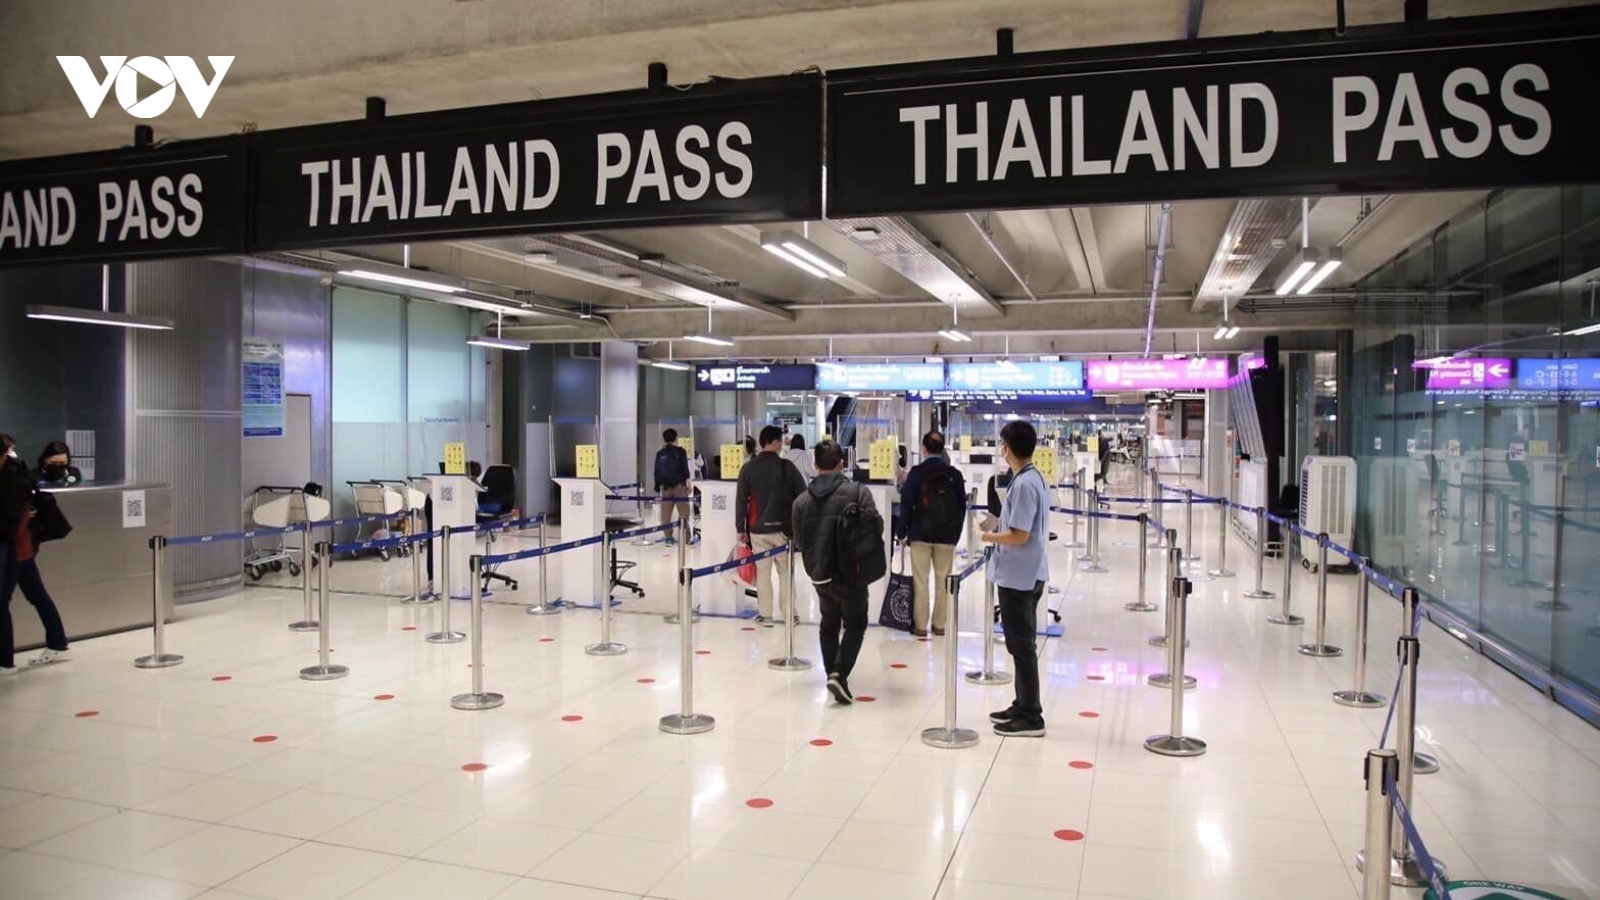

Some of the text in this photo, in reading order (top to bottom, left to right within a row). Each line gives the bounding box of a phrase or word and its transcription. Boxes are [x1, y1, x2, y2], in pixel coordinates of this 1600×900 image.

[899, 64, 1552, 185] THAILAND PASS
[98, 173, 204, 243] PASS
[301, 121, 754, 227] THAILAND PASS
[1494, 882, 1524, 890] WAY
